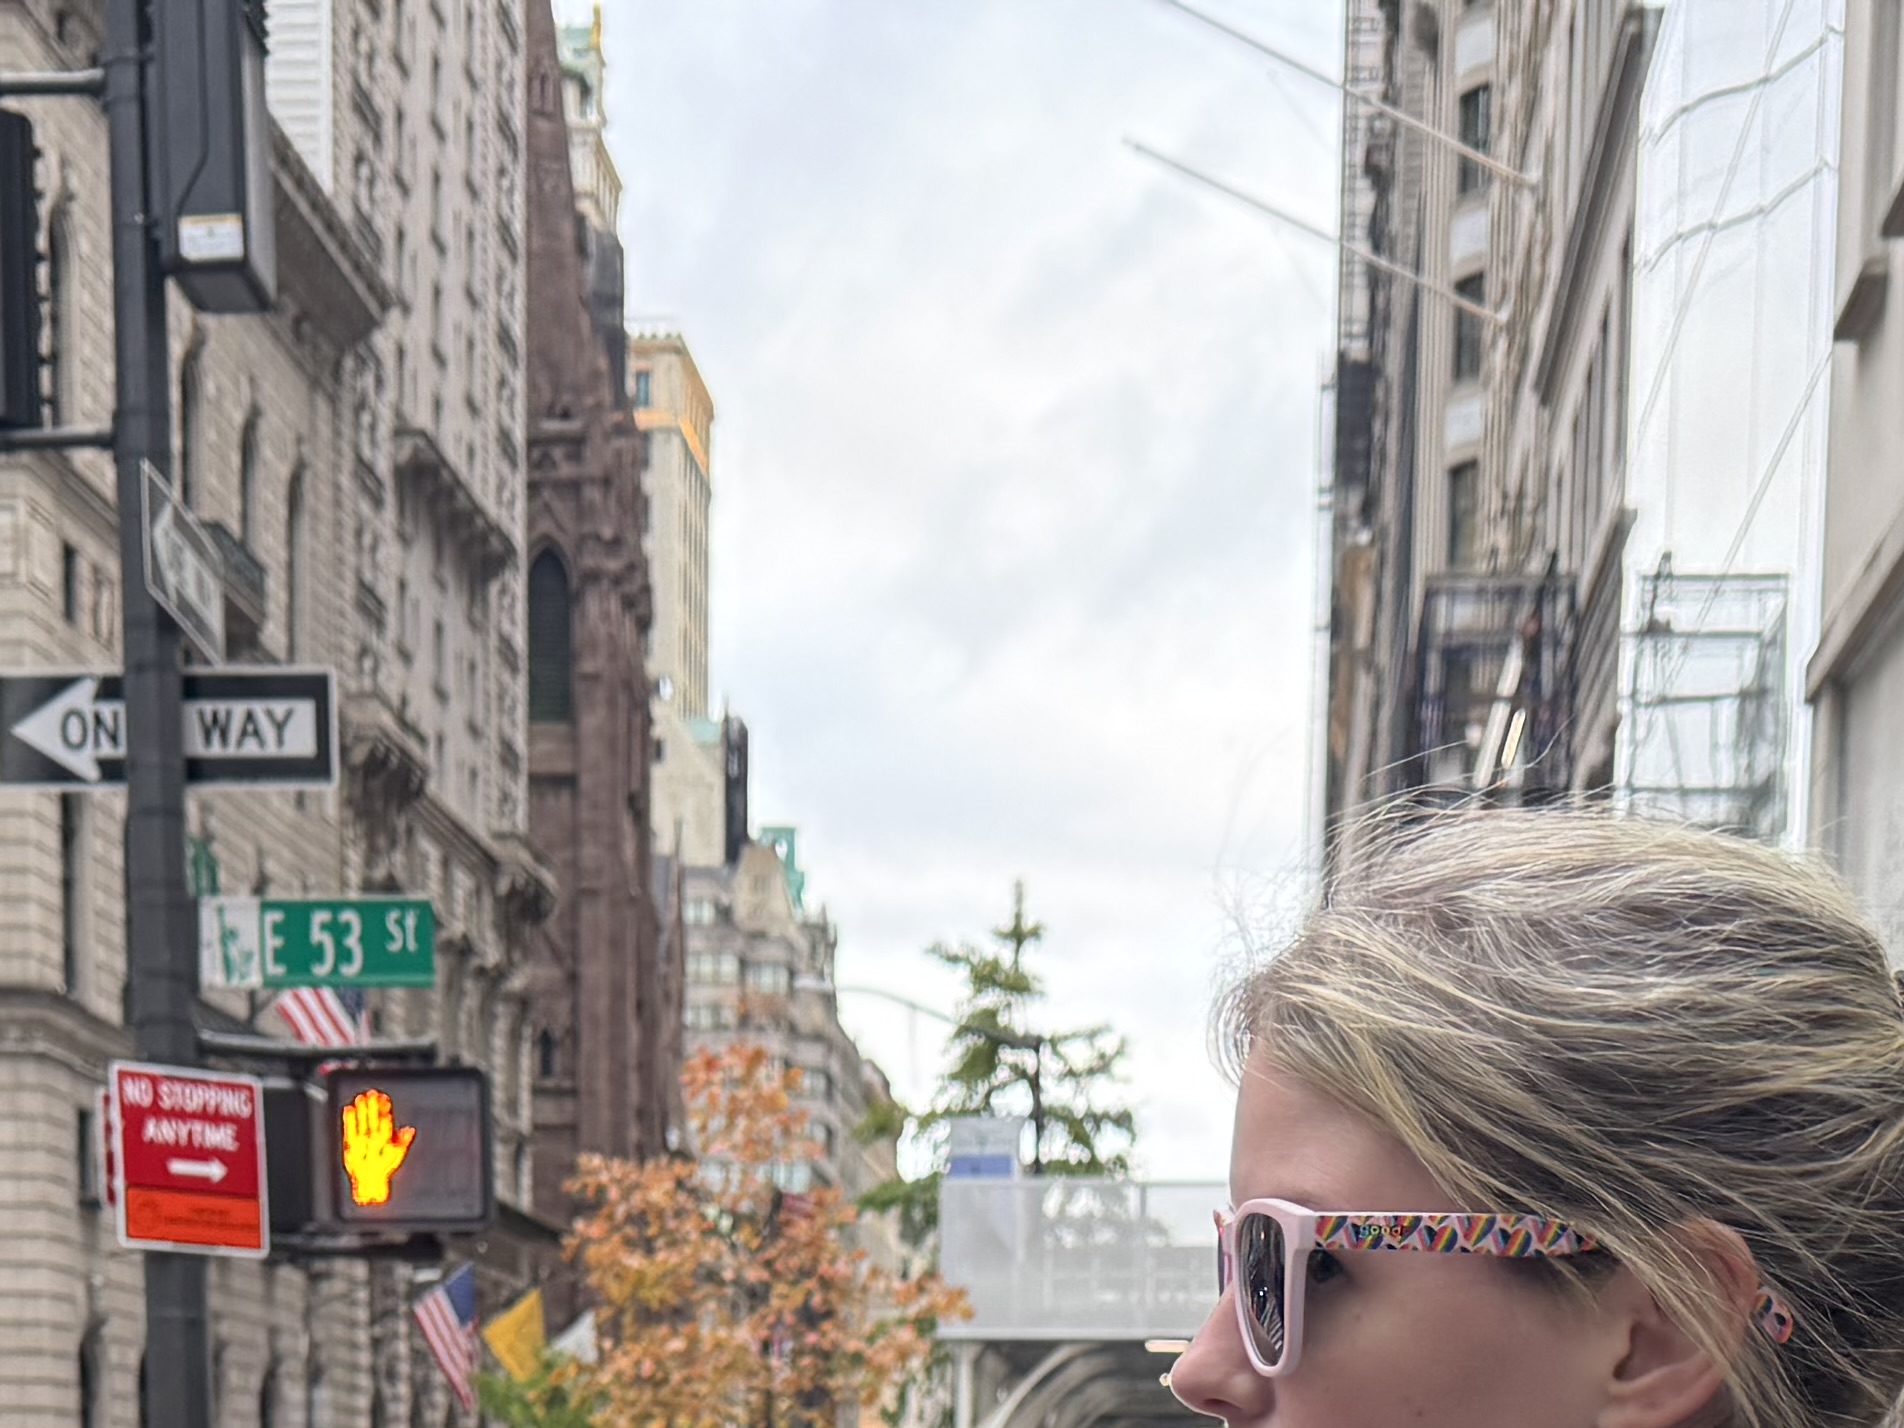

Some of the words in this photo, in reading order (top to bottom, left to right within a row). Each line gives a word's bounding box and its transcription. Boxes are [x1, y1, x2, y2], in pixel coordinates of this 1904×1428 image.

[61, 708, 121, 751] ON
[198, 707, 294, 750] WAY
[264, 910, 287, 977] E
[309, 908, 364, 977] 53
[122, 1075, 154, 1108] NO
[157, 1079, 253, 1118] STOPPING
[141, 1116, 240, 1152] ANYTIME
